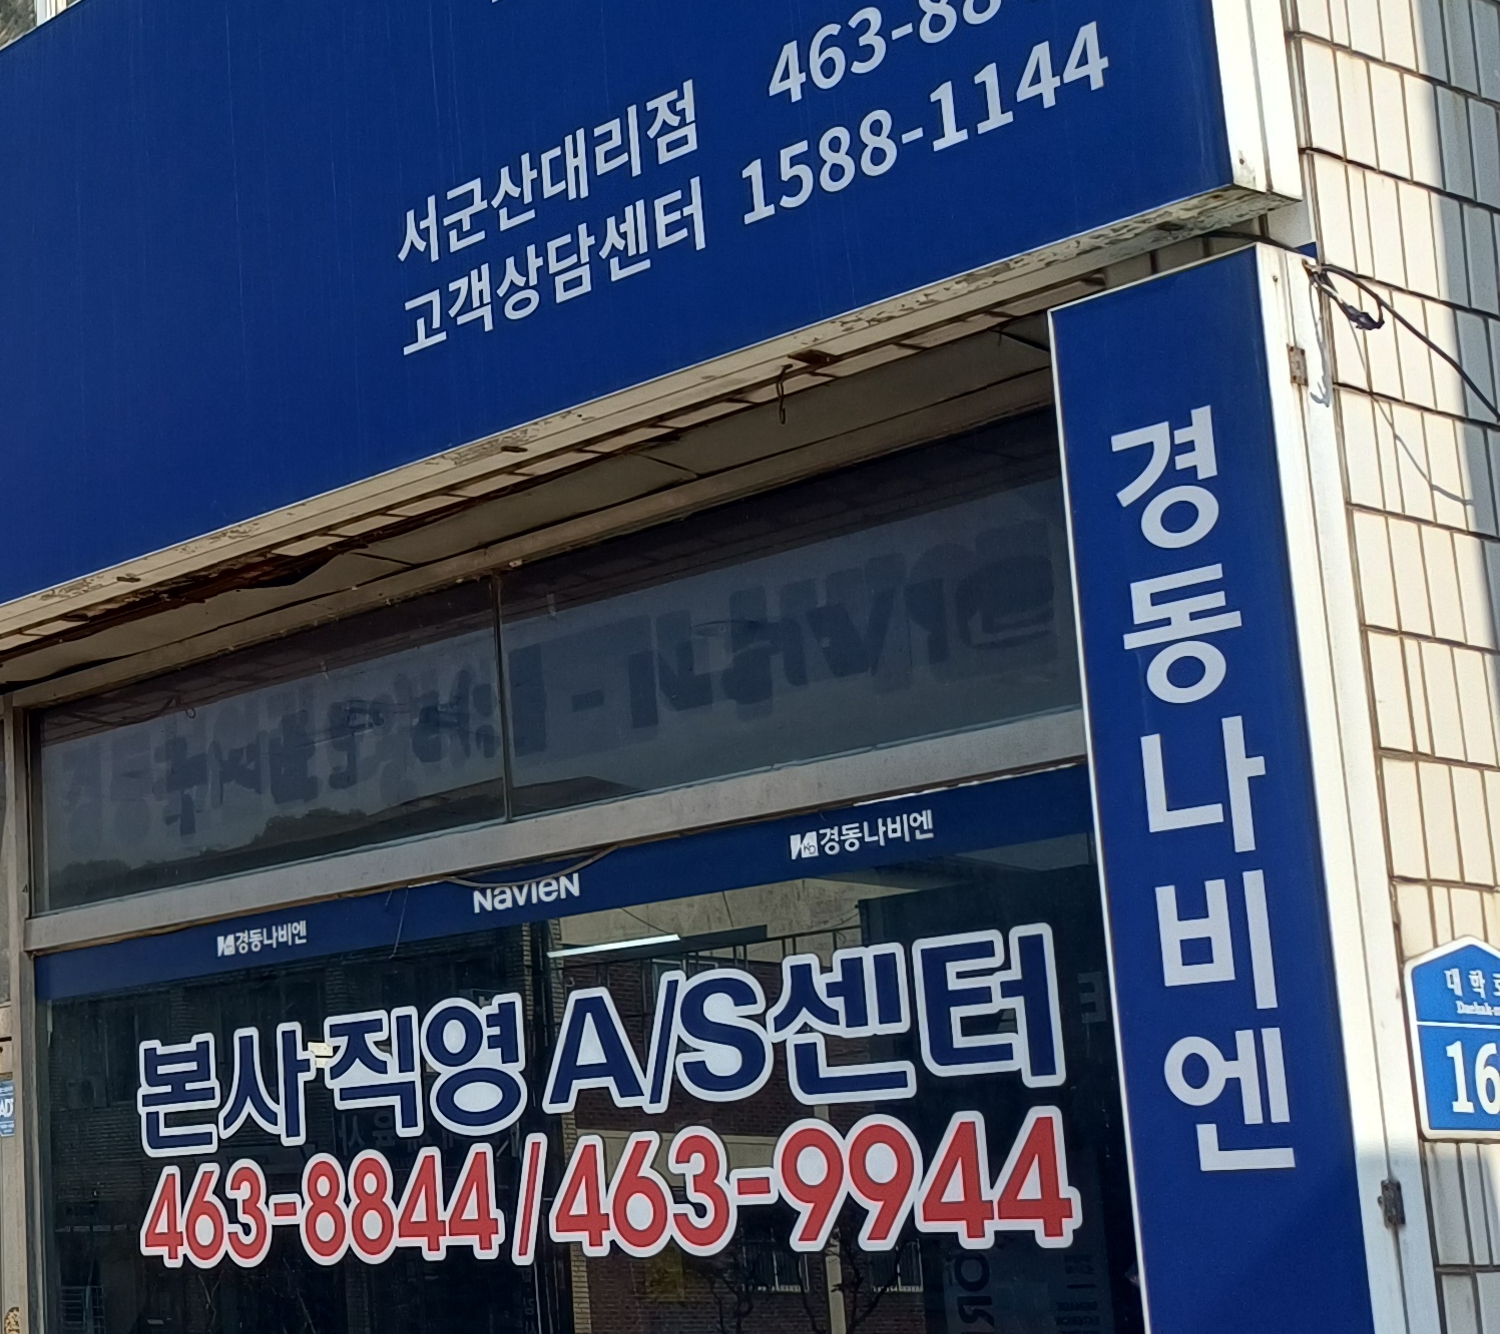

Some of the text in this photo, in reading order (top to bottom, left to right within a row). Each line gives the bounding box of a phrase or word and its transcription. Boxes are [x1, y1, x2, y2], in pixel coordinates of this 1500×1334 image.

[397, 79, 700, 268] 서군산대리점
[402, 20, 1110, 357] 고객상담센터 1588-1144
[819, 809, 934, 856] 경동나비엔
[1110, 404, 1297, 1174] 경동나비엔
[235, 920, 307, 954] 경동나비엔
[543, 921, 1067, 1117] A/S센터
